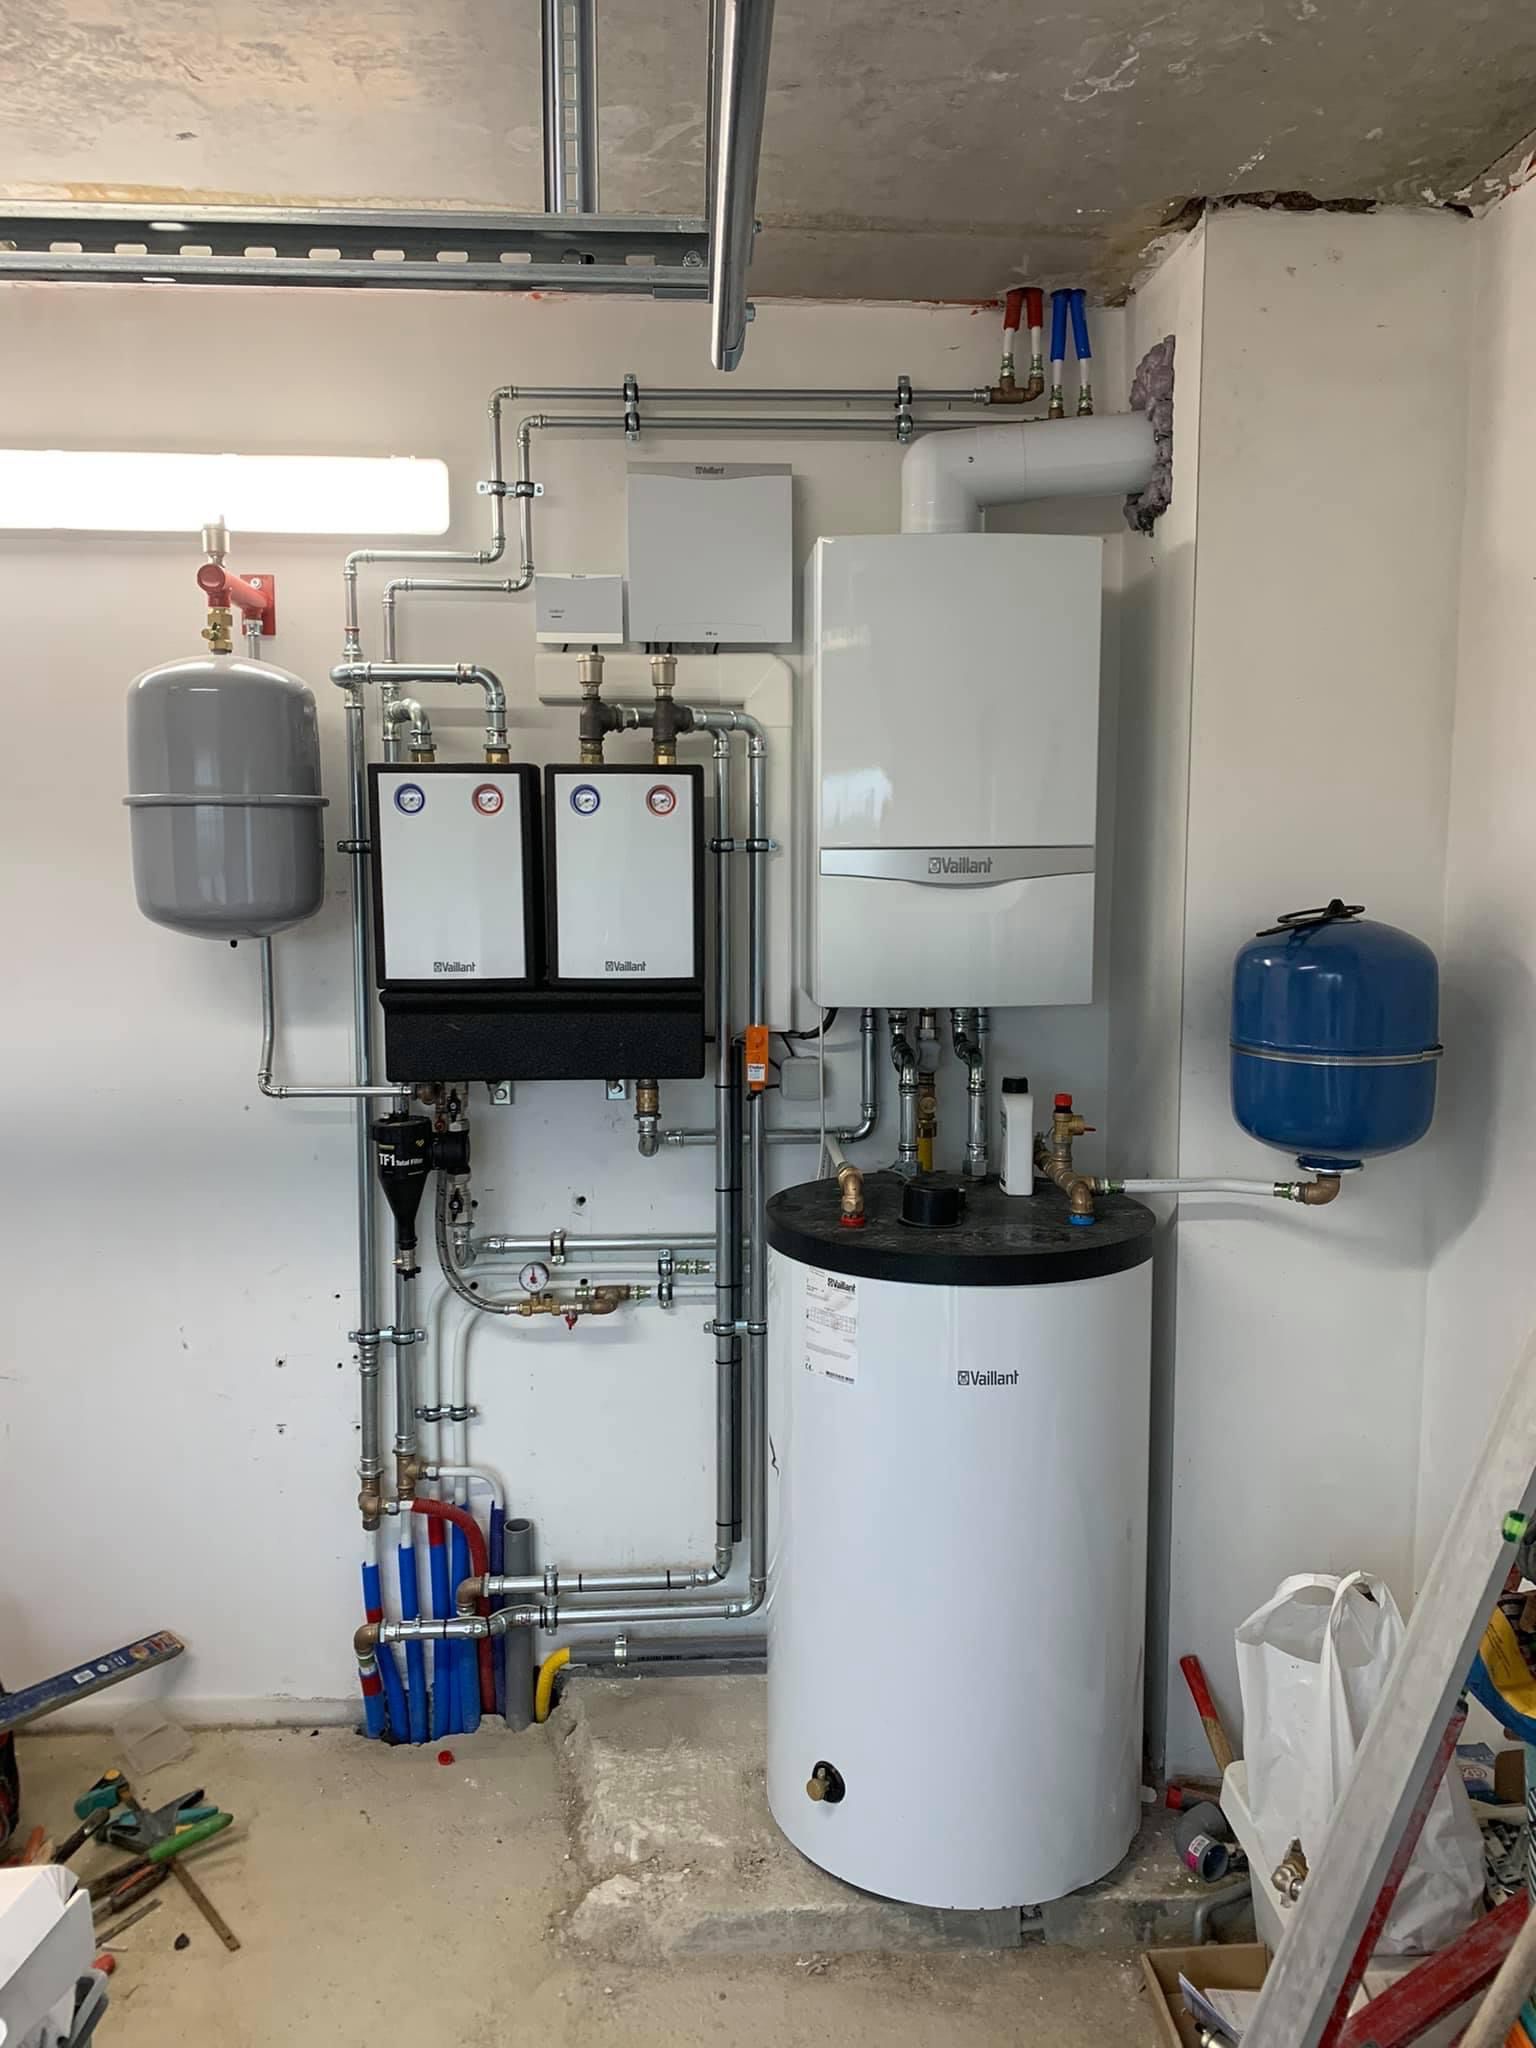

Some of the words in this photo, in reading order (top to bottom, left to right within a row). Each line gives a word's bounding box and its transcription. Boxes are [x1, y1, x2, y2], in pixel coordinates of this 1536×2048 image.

[942, 856, 992, 873] Vaillant
[442, 961, 475, 972] Vaillant
[613, 961, 646, 972] Vaillant
[379, 1153, 395, 1167] TF1
[834, 1279, 856, 1293] Vaillant
[970, 1369, 1019, 1385] Vaillant
